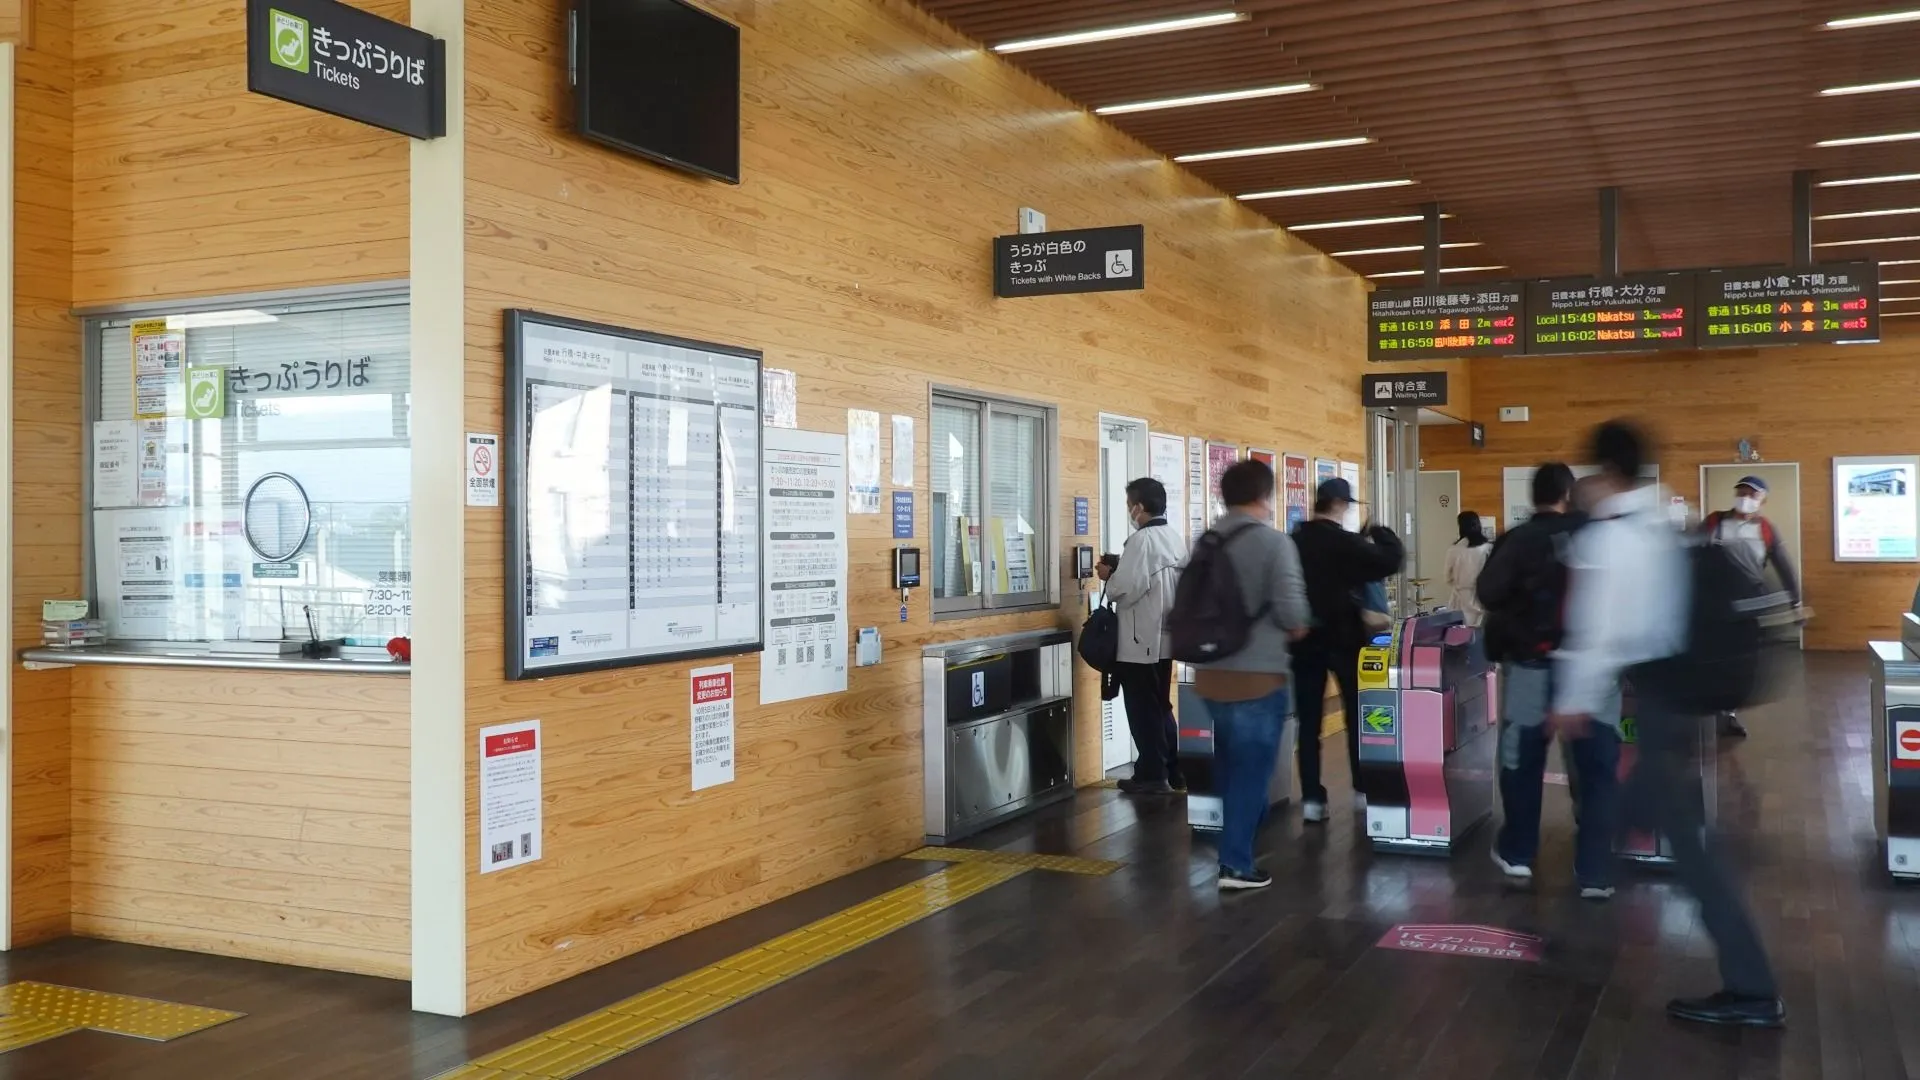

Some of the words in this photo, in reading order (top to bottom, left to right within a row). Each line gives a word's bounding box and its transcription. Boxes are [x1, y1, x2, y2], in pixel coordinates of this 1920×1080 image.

[312, 27, 425, 86] きっぷうりば
[313, 60, 361, 90] Tickets
[1010, 240, 1086, 258] うらが白色の
[1010, 259, 1047, 274] きっぷ
[1010, 276, 1036, 285] Tickets
[1038, 275, 1053, 283] with
[1054, 274, 1076, 282] White
[1077, 272, 1101, 281] Backs
[1724, 280, 1761, 291] 日豊本線
[1763, 274, 1825, 289] 小倉・下関
[1828, 275, 1848, 285] 方面
[1552, 290, 1586, 300] 日豊本線
[1588, 284, 1645, 298] 行橋・大分
[1648, 286, 1666, 295] 方面
[1748, 290, 1764, 298] Line
[1766, 289, 1778, 297] for
[1780, 288, 1810, 297] Kokura,
[1812, 285, 1860, 295] Shimonoseki
[1372, 300, 1411, 310] 日田彦山線
[1413, 292, 1500, 308] 田川後藤寺・添田
[1502, 294, 1519, 303] 方面
[1574, 300, 1589, 308] Line
[1604, 298, 1643, 306] Yukuhashi,
[1372, 308, 1411, 317] Hitahikosan
[1412, 308, 1426, 316] Line
[1488, 304, 1509, 312] Soeda
[1708, 305, 1730, 317] 普通
[1733, 303, 1772, 315] 15:48
[1536, 314, 1558, 325] Local
[1561, 312, 1596, 324] 15:49
[1597, 311, 1635, 322] Nakatsu
[1379, 322, 1398, 332] 普通
[1401, 320, 1434, 331] 16:19
[1708, 323, 1730, 335] 普通
[1733, 322, 1772, 334] 16:06
[1379, 339, 1398, 349] 普通
[1401, 337, 1434, 348] 16:59
[1536, 332, 1558, 343] Local
[1561, 330, 1596, 342] 16:02
[1597, 329, 1635, 340] Nakatsu
[229, 356, 371, 394] きっぷうりば
[1394, 380, 1427, 392] 待合室
[235, 400, 281, 418] Tickets
[469, 477, 496, 489] 全面禁煙
[1399, 940, 1523, 957] 専用通路
